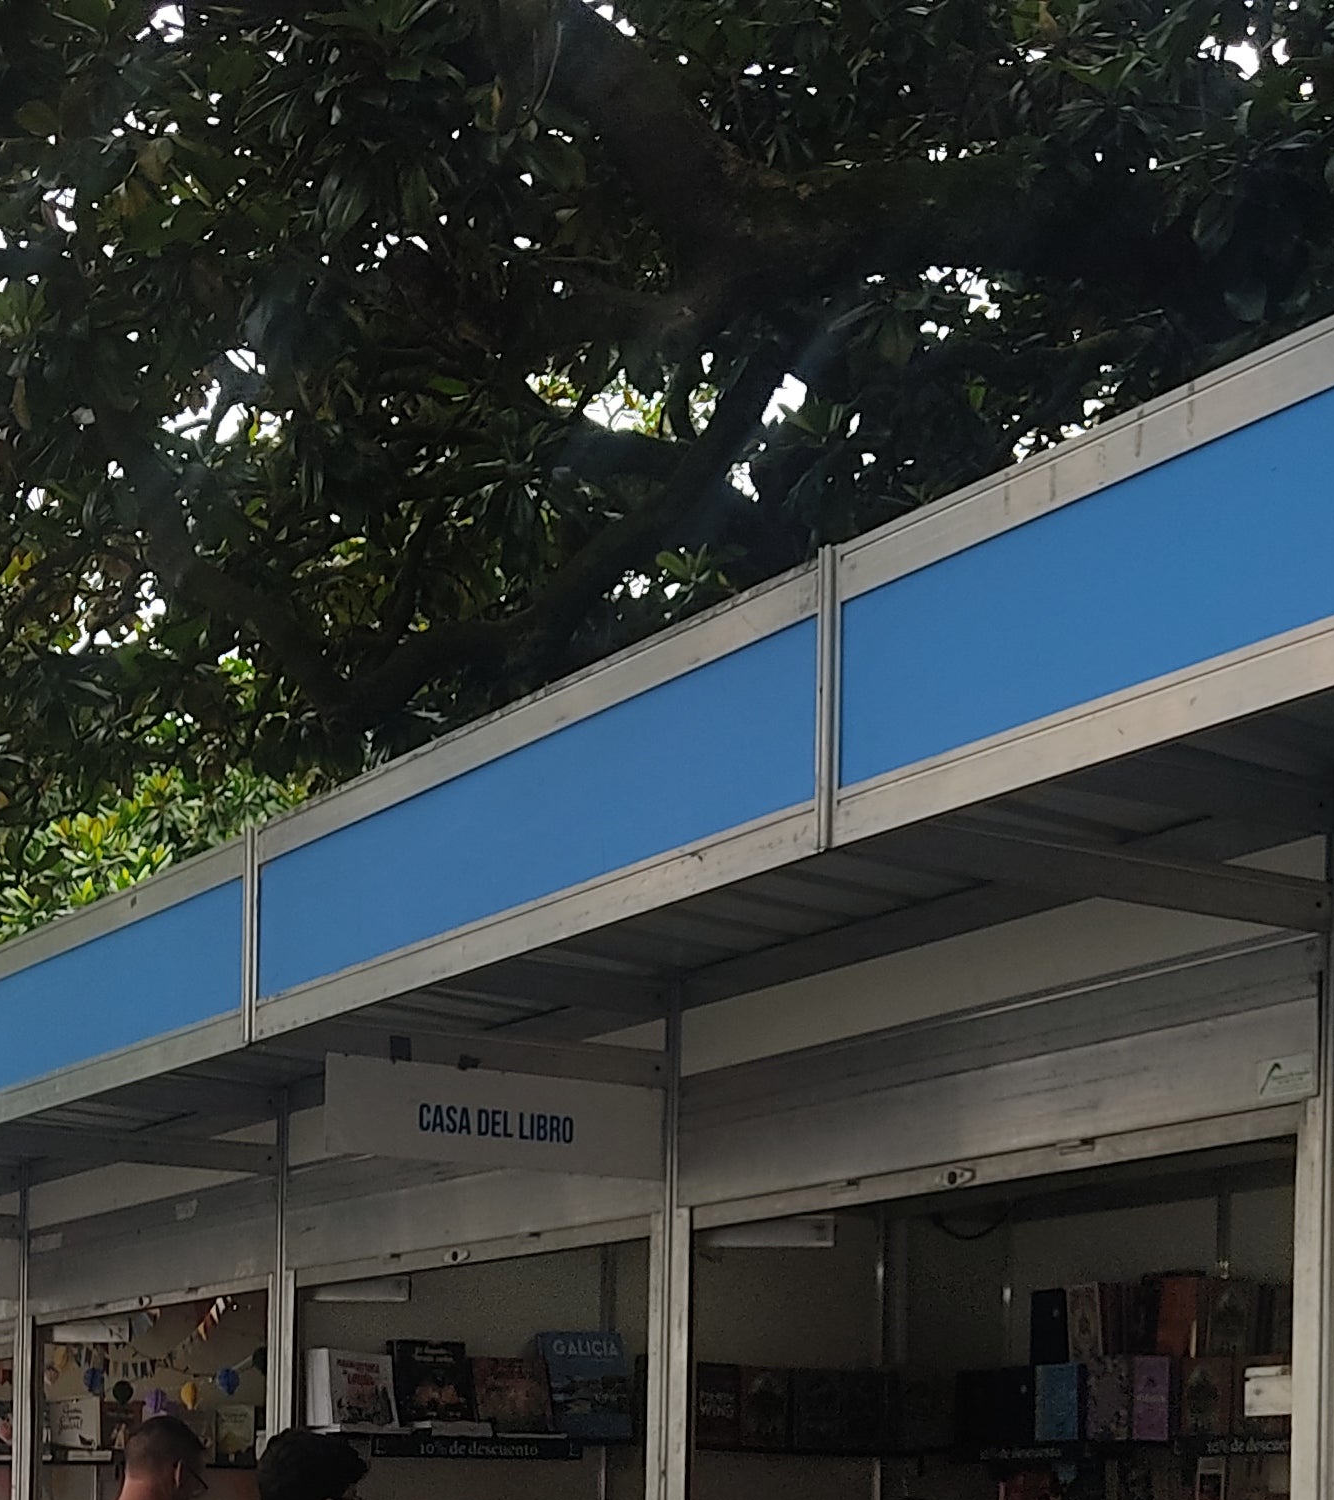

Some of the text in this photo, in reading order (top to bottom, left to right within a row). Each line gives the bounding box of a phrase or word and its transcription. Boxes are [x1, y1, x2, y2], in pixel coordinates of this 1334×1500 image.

[418, 1103, 574, 1144] CASA DEL LIBRO
[552, 1339, 619, 1357] GALICIA
[449, 1440, 466, 1455] de
[468, 1440, 539, 1457] descuento
